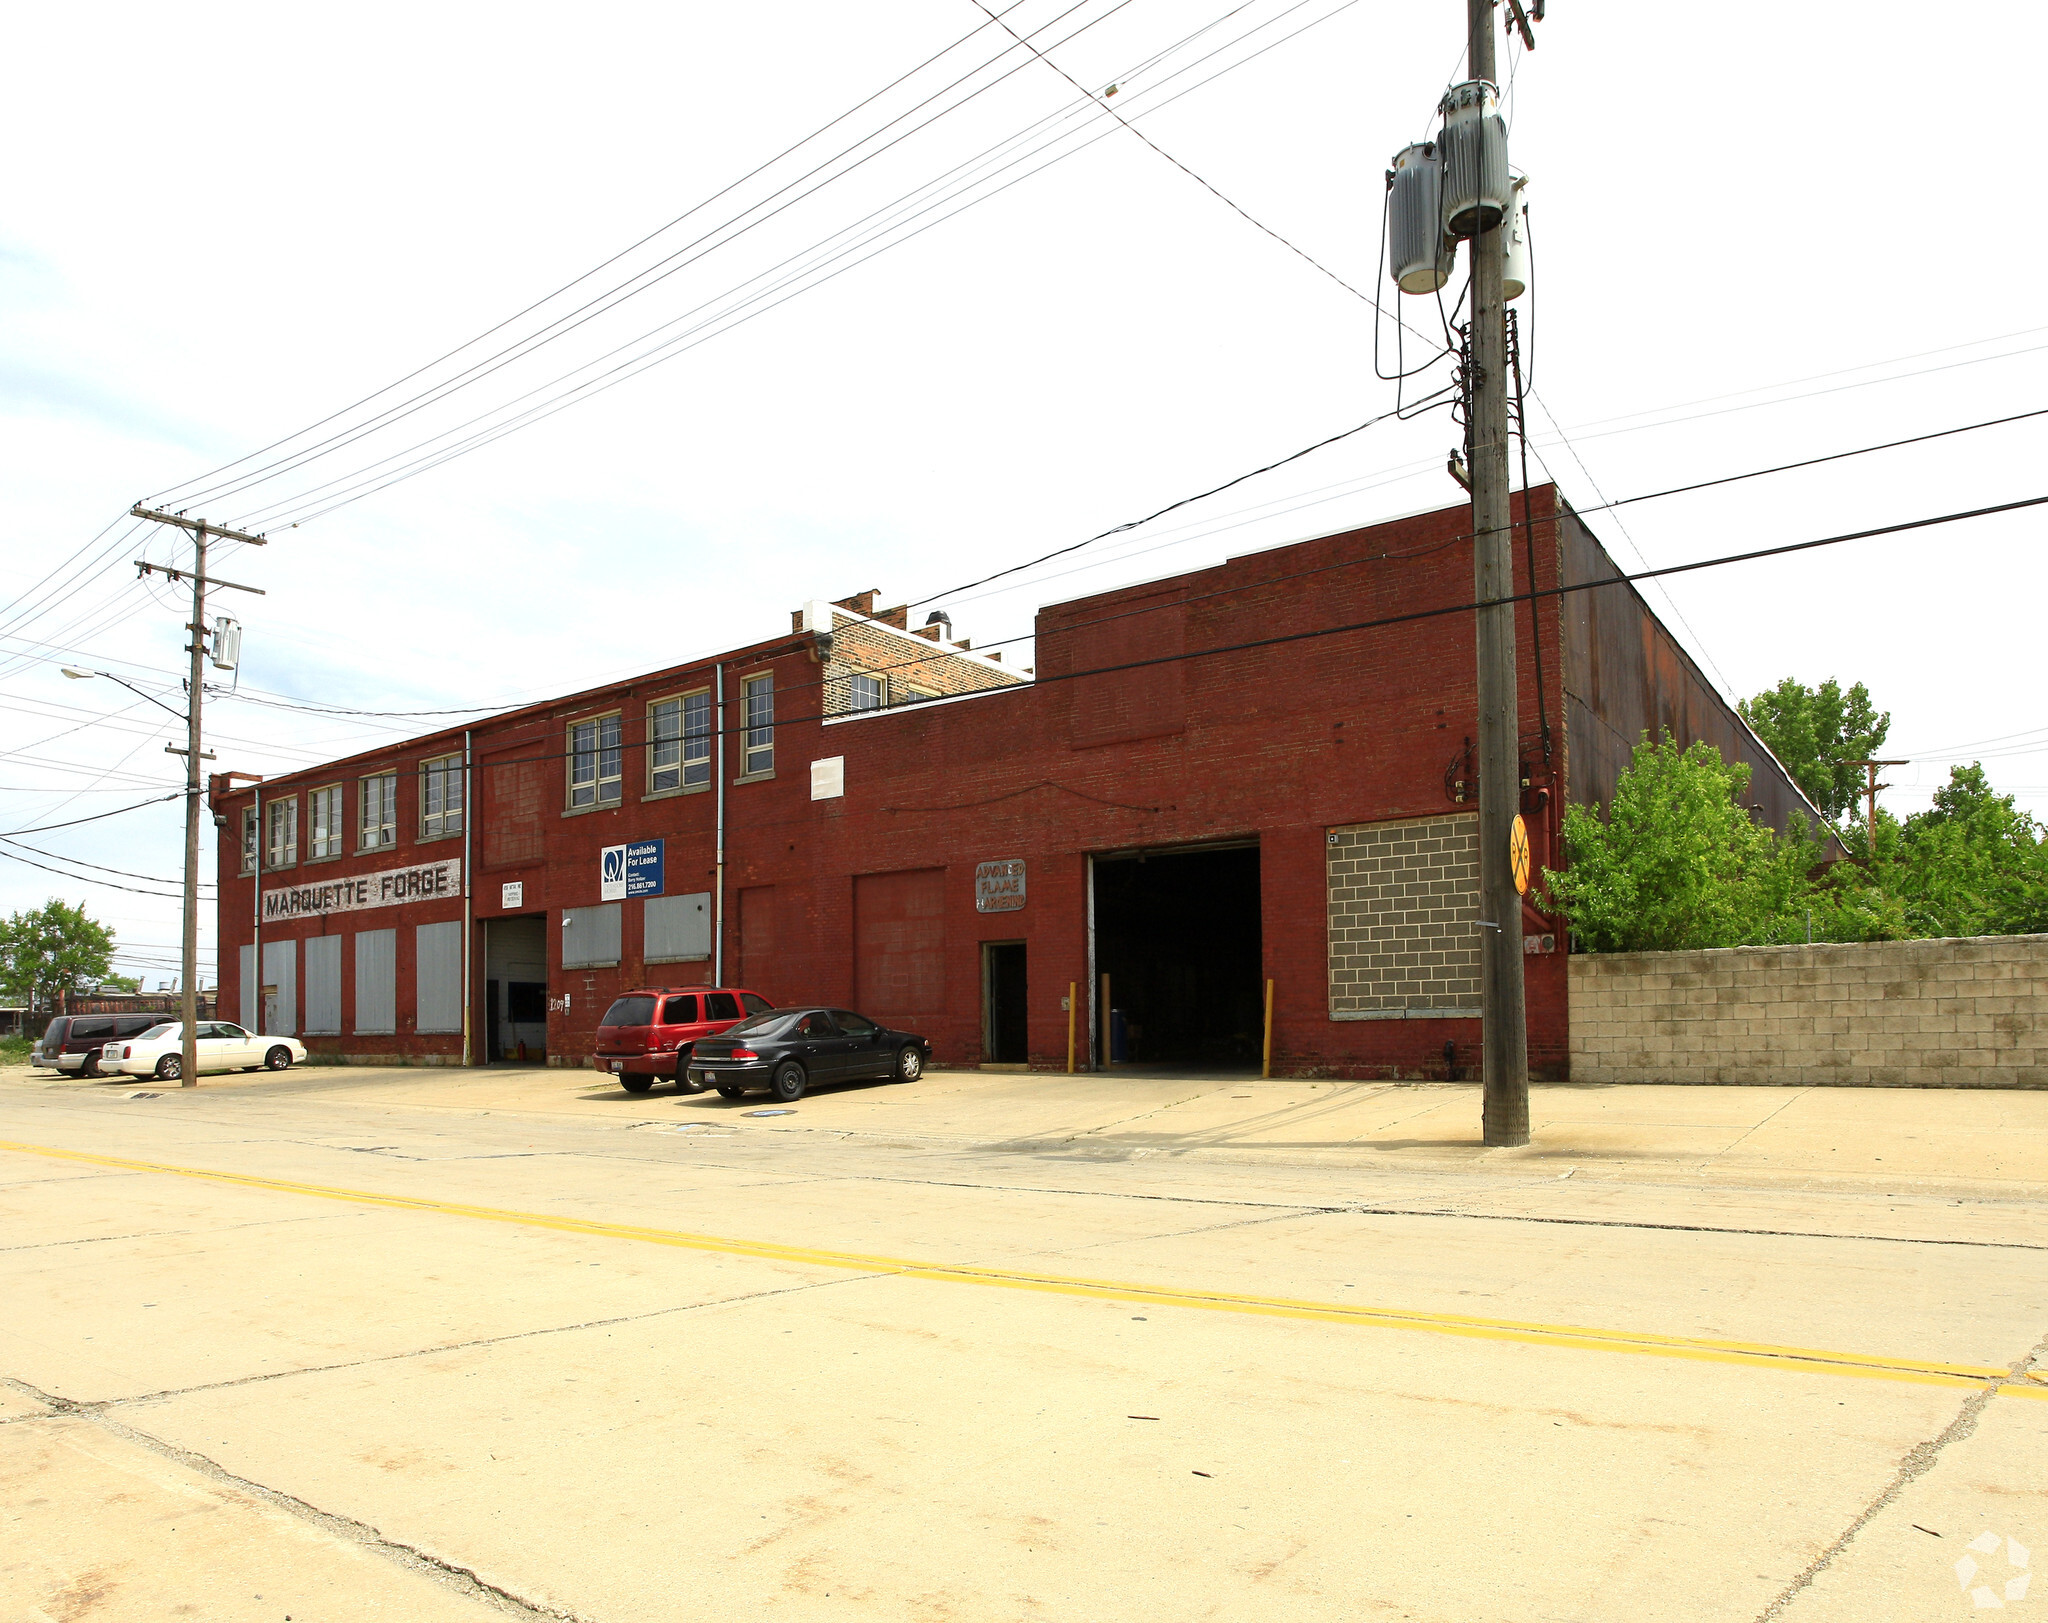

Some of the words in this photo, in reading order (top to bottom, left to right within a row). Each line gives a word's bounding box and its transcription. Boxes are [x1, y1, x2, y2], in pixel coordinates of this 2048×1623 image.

[628, 845, 656, 856] Available
[628, 857, 638, 867] For
[640, 857, 657, 865] Lease
[976, 863, 1024, 879] ADVANCED
[266, 880, 368, 916] MARQUETTE
[381, 866, 448, 900] FORGE
[981, 879, 1019, 894] FLAME
